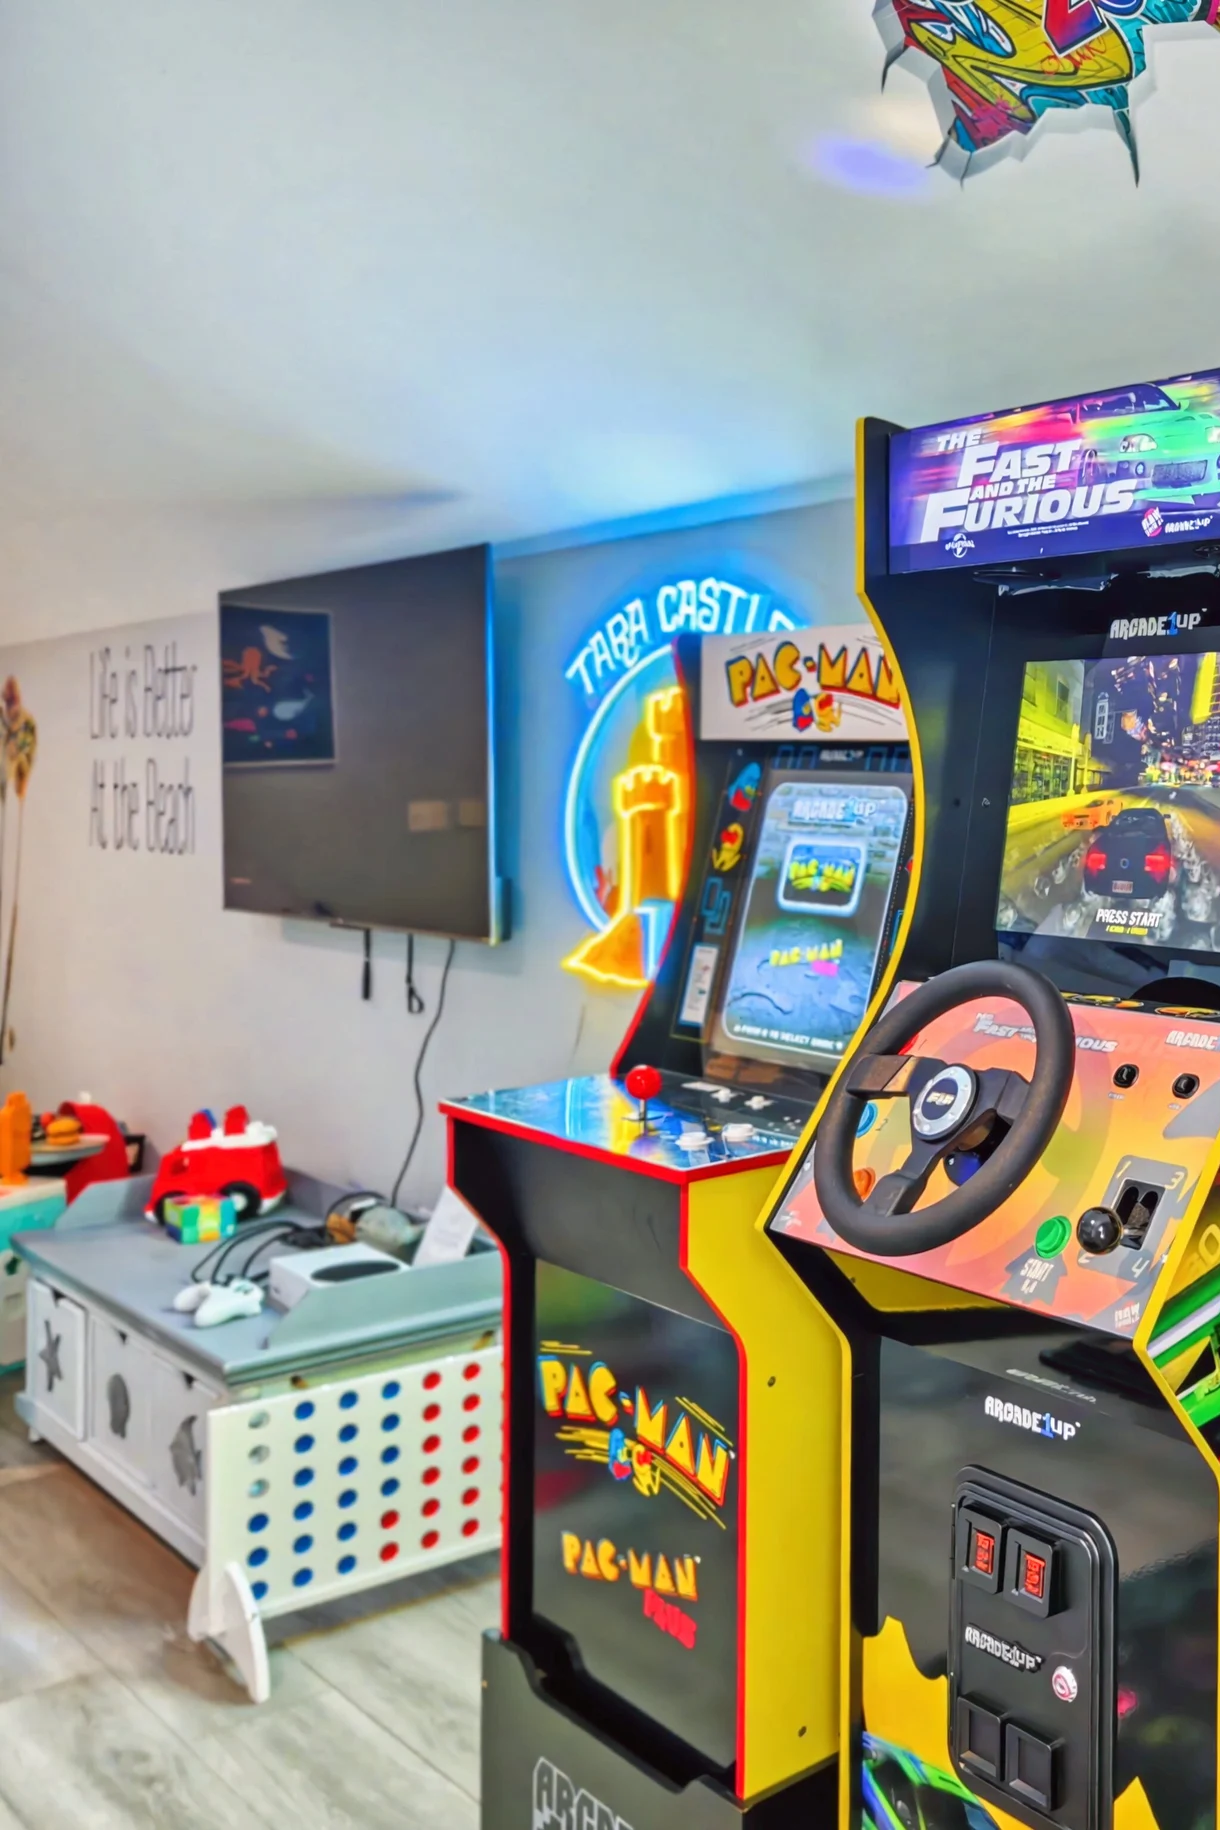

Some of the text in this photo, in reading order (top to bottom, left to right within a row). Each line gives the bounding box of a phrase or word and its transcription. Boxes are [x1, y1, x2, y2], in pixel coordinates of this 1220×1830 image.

[937, 429, 984, 452] THE
[956, 439, 1083, 488] FAST
[920, 479, 1138, 544] FURIOUS
[969, 475, 1056, 501] AND THE
[89, 641, 198, 740] Life is Better
[89, 756, 196, 855] At the Beach
[1096, 908, 1163, 928] PRESS START
[1164, 1171, 1185, 1190] 3
[1131, 1257, 1150, 1279] 4
[537, 1355, 730, 1506] PAC-MAN
[984, 1395, 1076, 1441] ARCADE1UP
[561, 1530, 698, 1601] PAC-MAN
